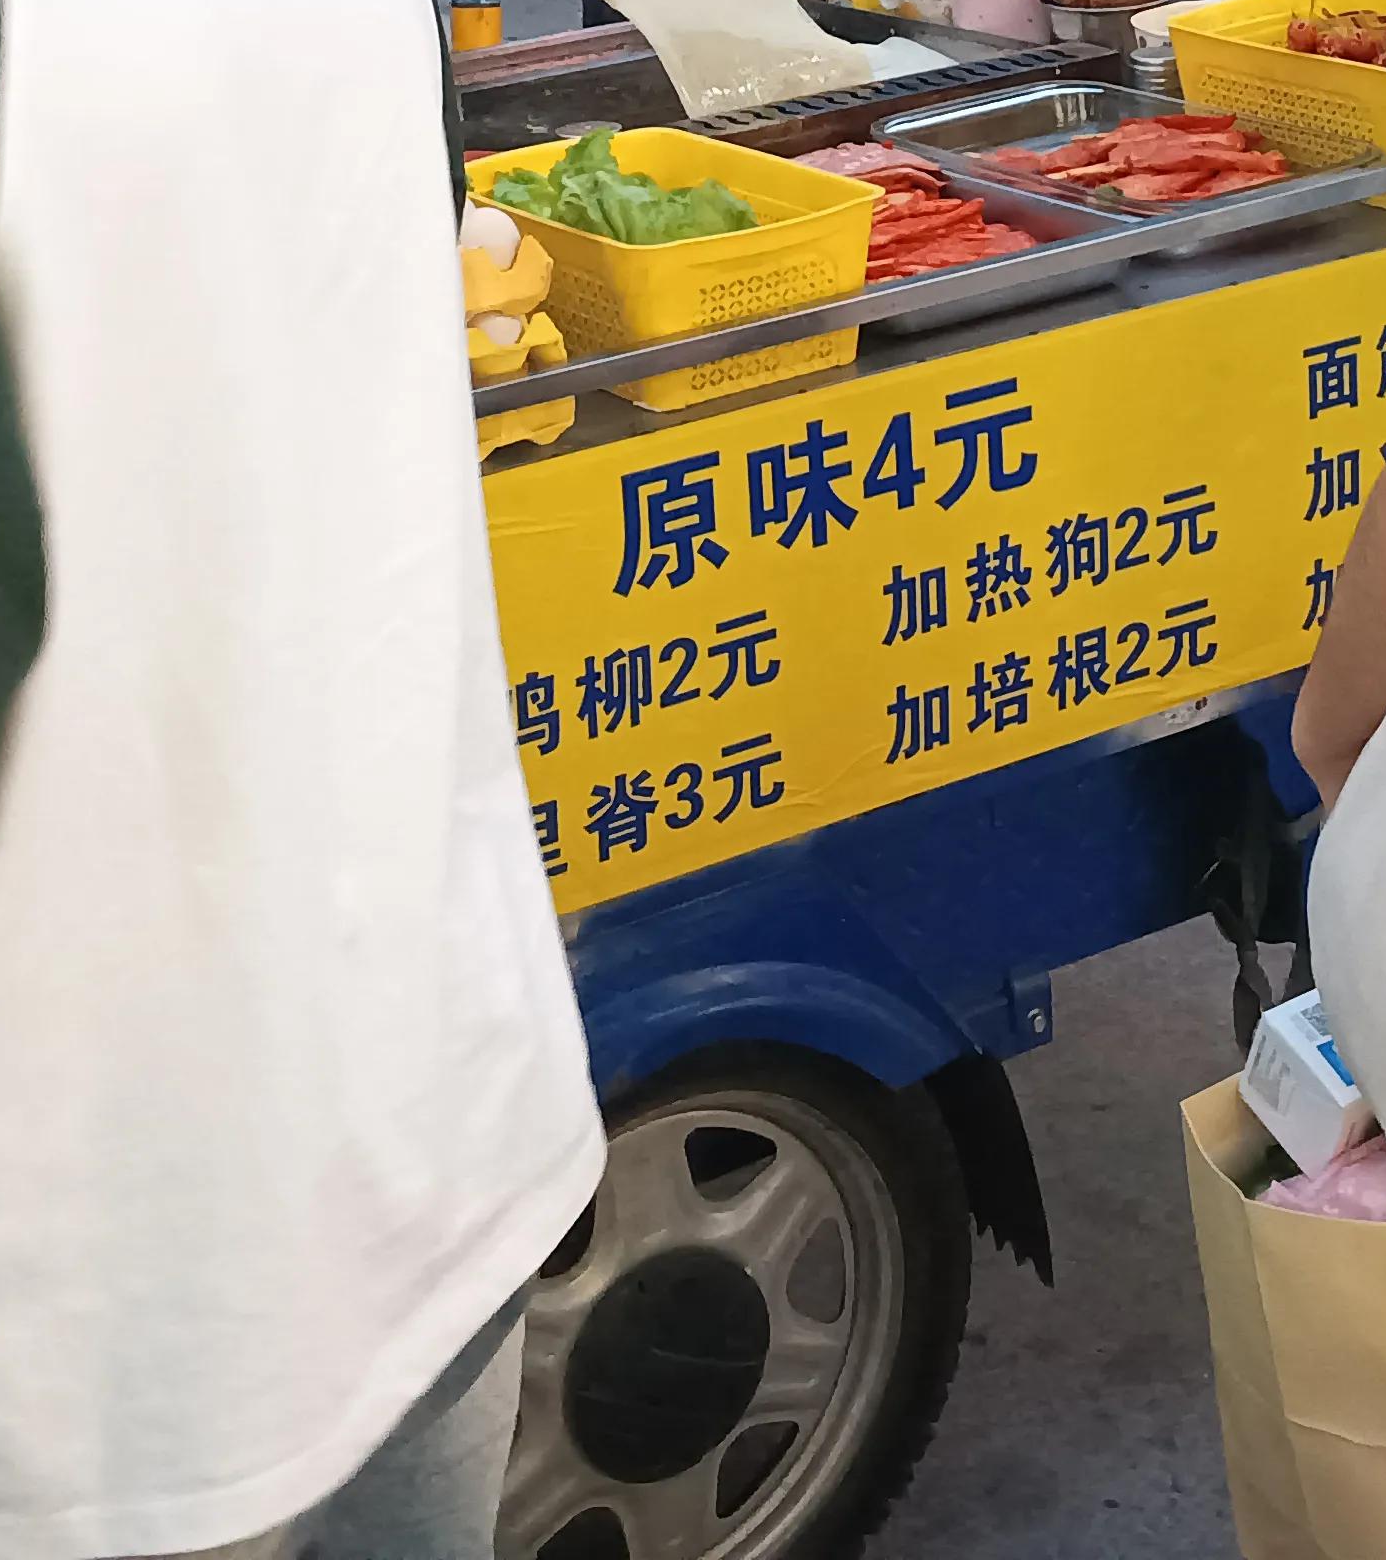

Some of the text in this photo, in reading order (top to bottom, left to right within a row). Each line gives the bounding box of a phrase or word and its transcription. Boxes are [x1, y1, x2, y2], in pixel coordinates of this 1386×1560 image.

[612, 377, 1040, 598] 原味4元
[882, 483, 1219, 647] 加热狗2元
[884, 597, 1219, 764] 加培根2元
